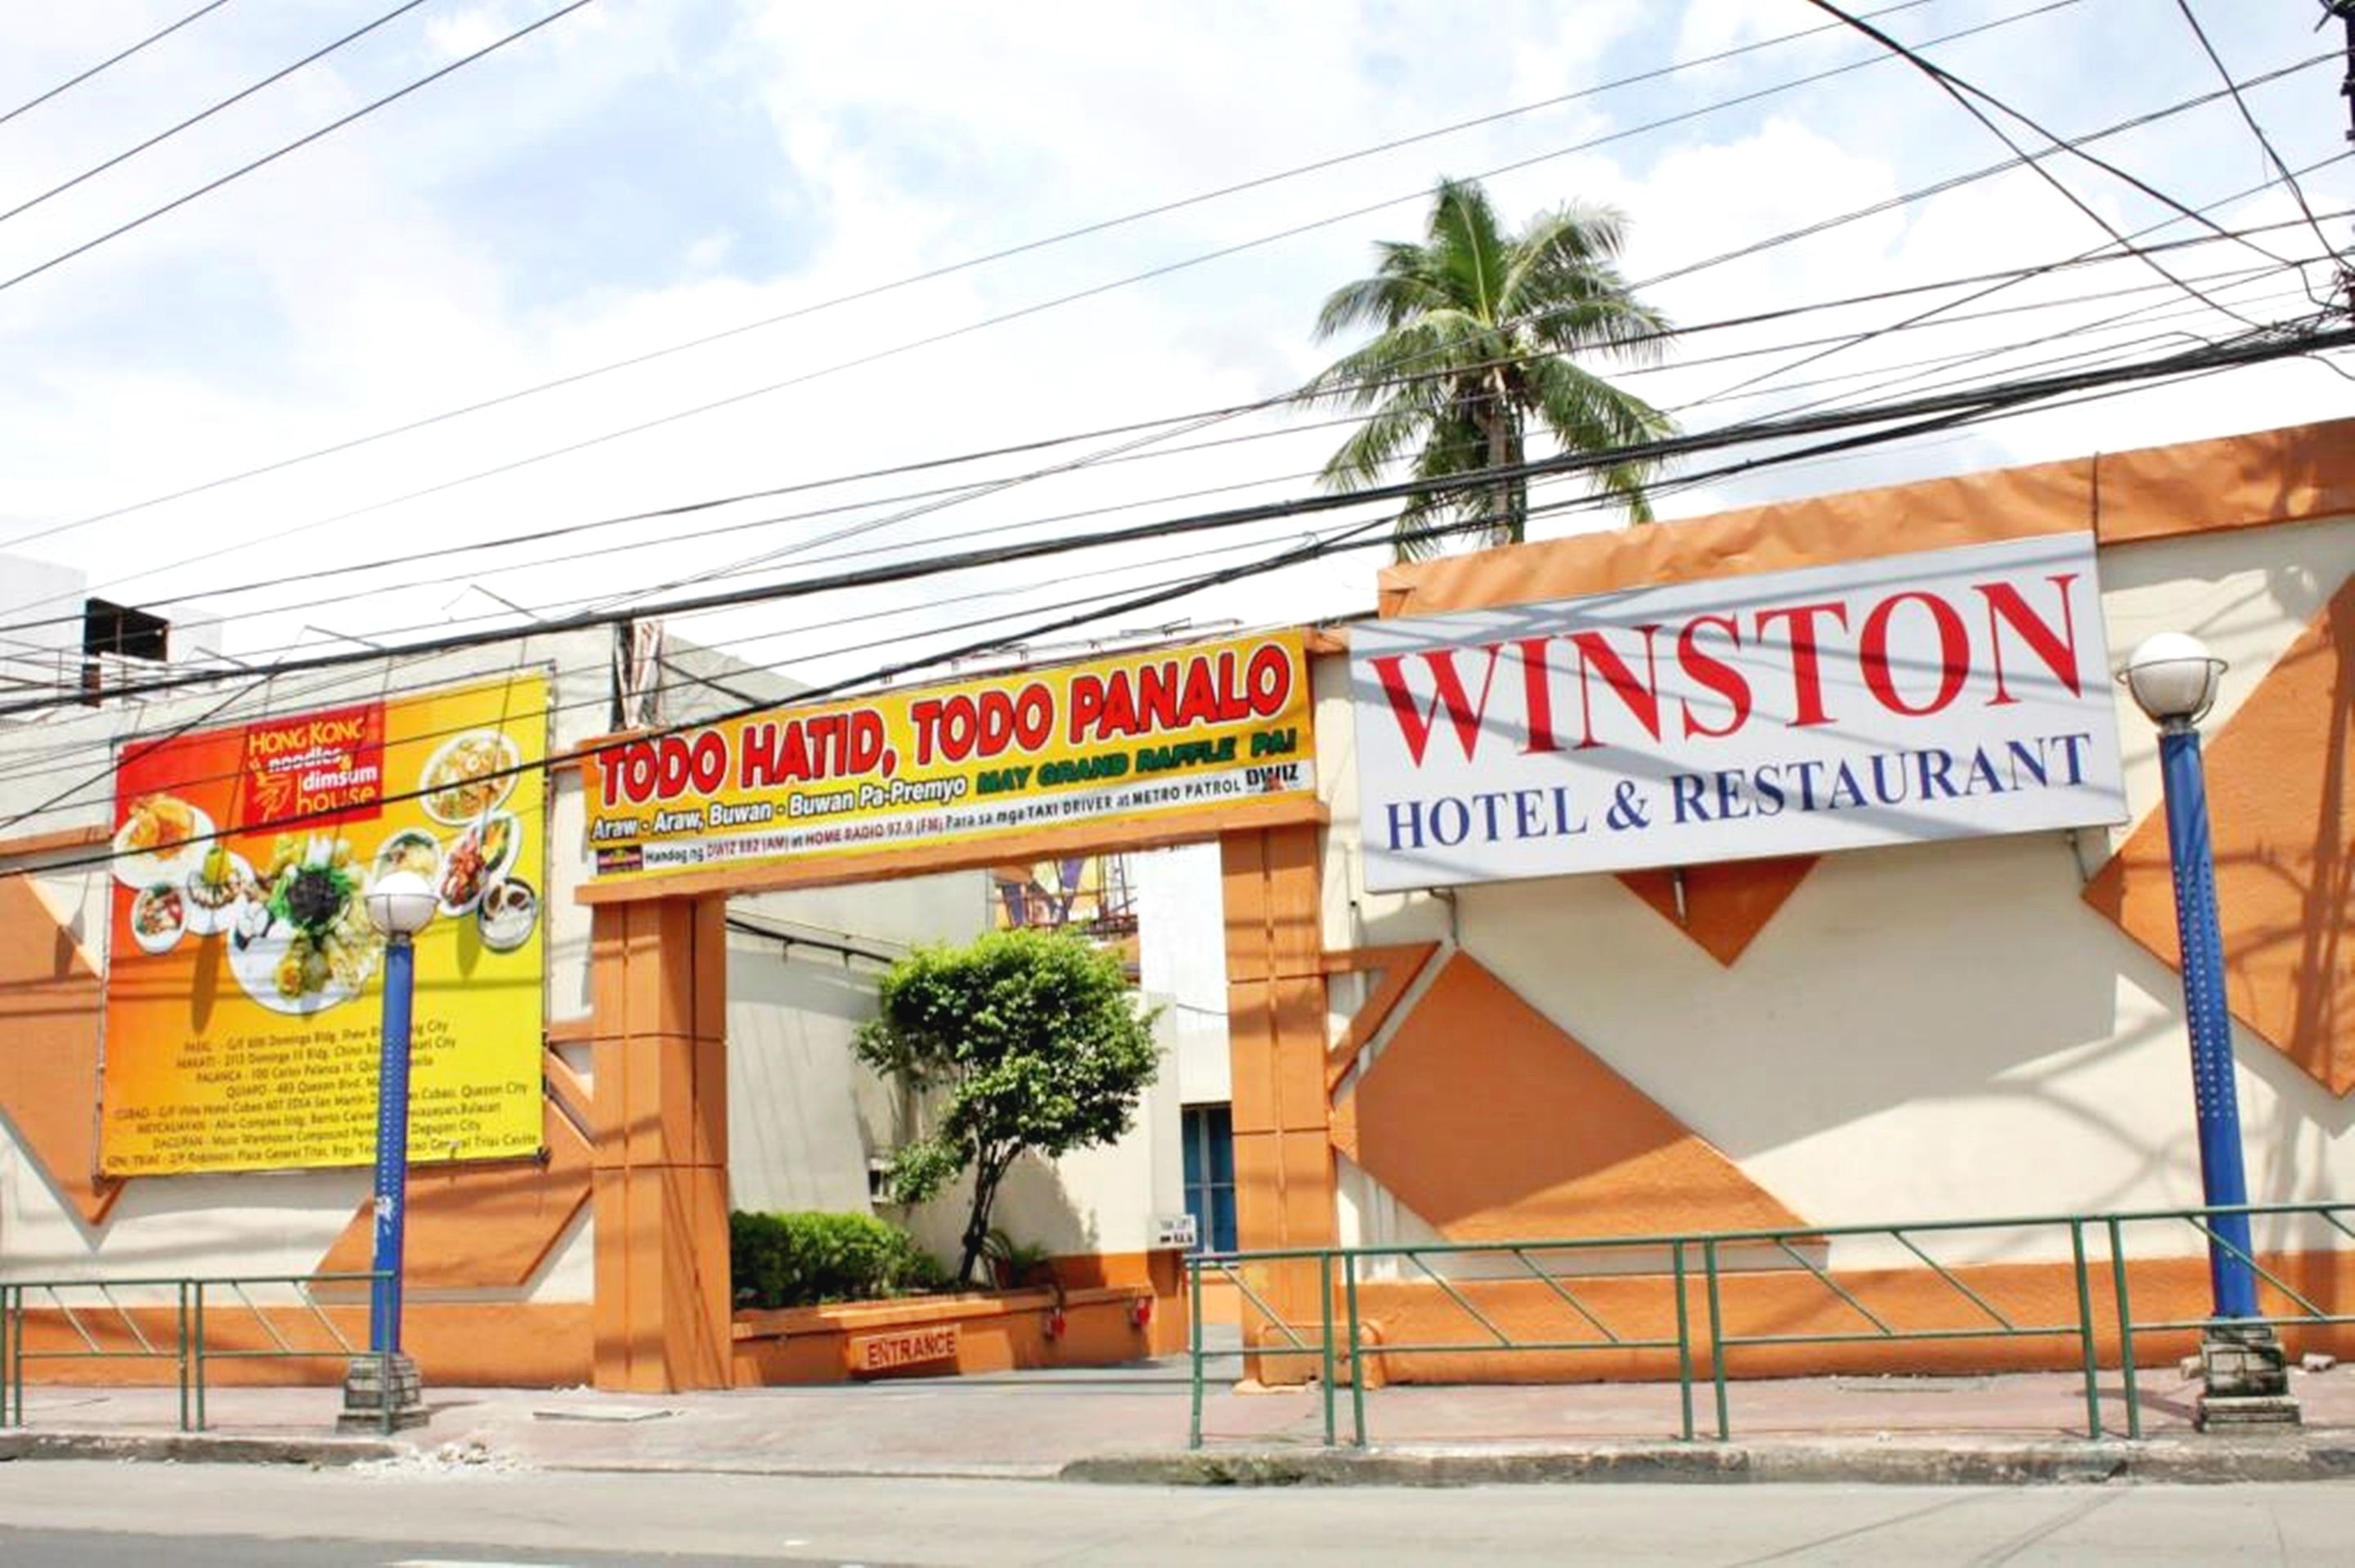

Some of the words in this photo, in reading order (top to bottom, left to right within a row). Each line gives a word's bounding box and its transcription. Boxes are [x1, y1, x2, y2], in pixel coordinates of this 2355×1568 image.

[1368, 573, 2081, 768] WINSTON
[249, 727, 307, 755] HONG
[309, 717, 366, 746] KONG
[599, 730, 727, 807] TODO
[741, 709, 896, 790] HATID,
[912, 683, 1053, 765] TODO
[1069, 644, 1291, 744] PANALO
[267, 746, 342, 773] noodles
[1246, 763, 1299, 786] DWIZ
[302, 766, 378, 791] dimsum
[592, 817, 639, 840] Araw
[709, 802, 772, 826] Buwan
[789, 791, 855, 818] Buwan
[859, 777, 967, 810] Pa-Premyo
[976, 765, 1033, 795] MAY
[1038, 753, 1128, 786] GRAND
[1136, 737, 1237, 773] RAFFLE
[1385, 786, 1587, 850] HOTEL
[1606, 780, 1651, 831] &
[1669, 732, 2092, 823] RESTAURANT
[296, 773, 377, 817] house
[805, 828, 841, 845] HOME
[845, 823, 884, 842] RADIO
[946, 814, 975, 829] Para
[997, 809, 1024, 825] mga
[1026, 804, 1058, 818] TAXI
[1062, 795, 1112, 814] DRIVER
[1132, 786, 1180, 804] METRO
[1186, 778, 1241, 798] PATROL
[427, 1020, 448, 1035] City
[434, 1036, 456, 1051] City
[196, 1069, 240, 1084] PALANCA
[226, 1083, 266, 1099] QUIAPO
[505, 1082, 527, 1097] City
[868, 1331, 956, 1366] ENTRANCE
